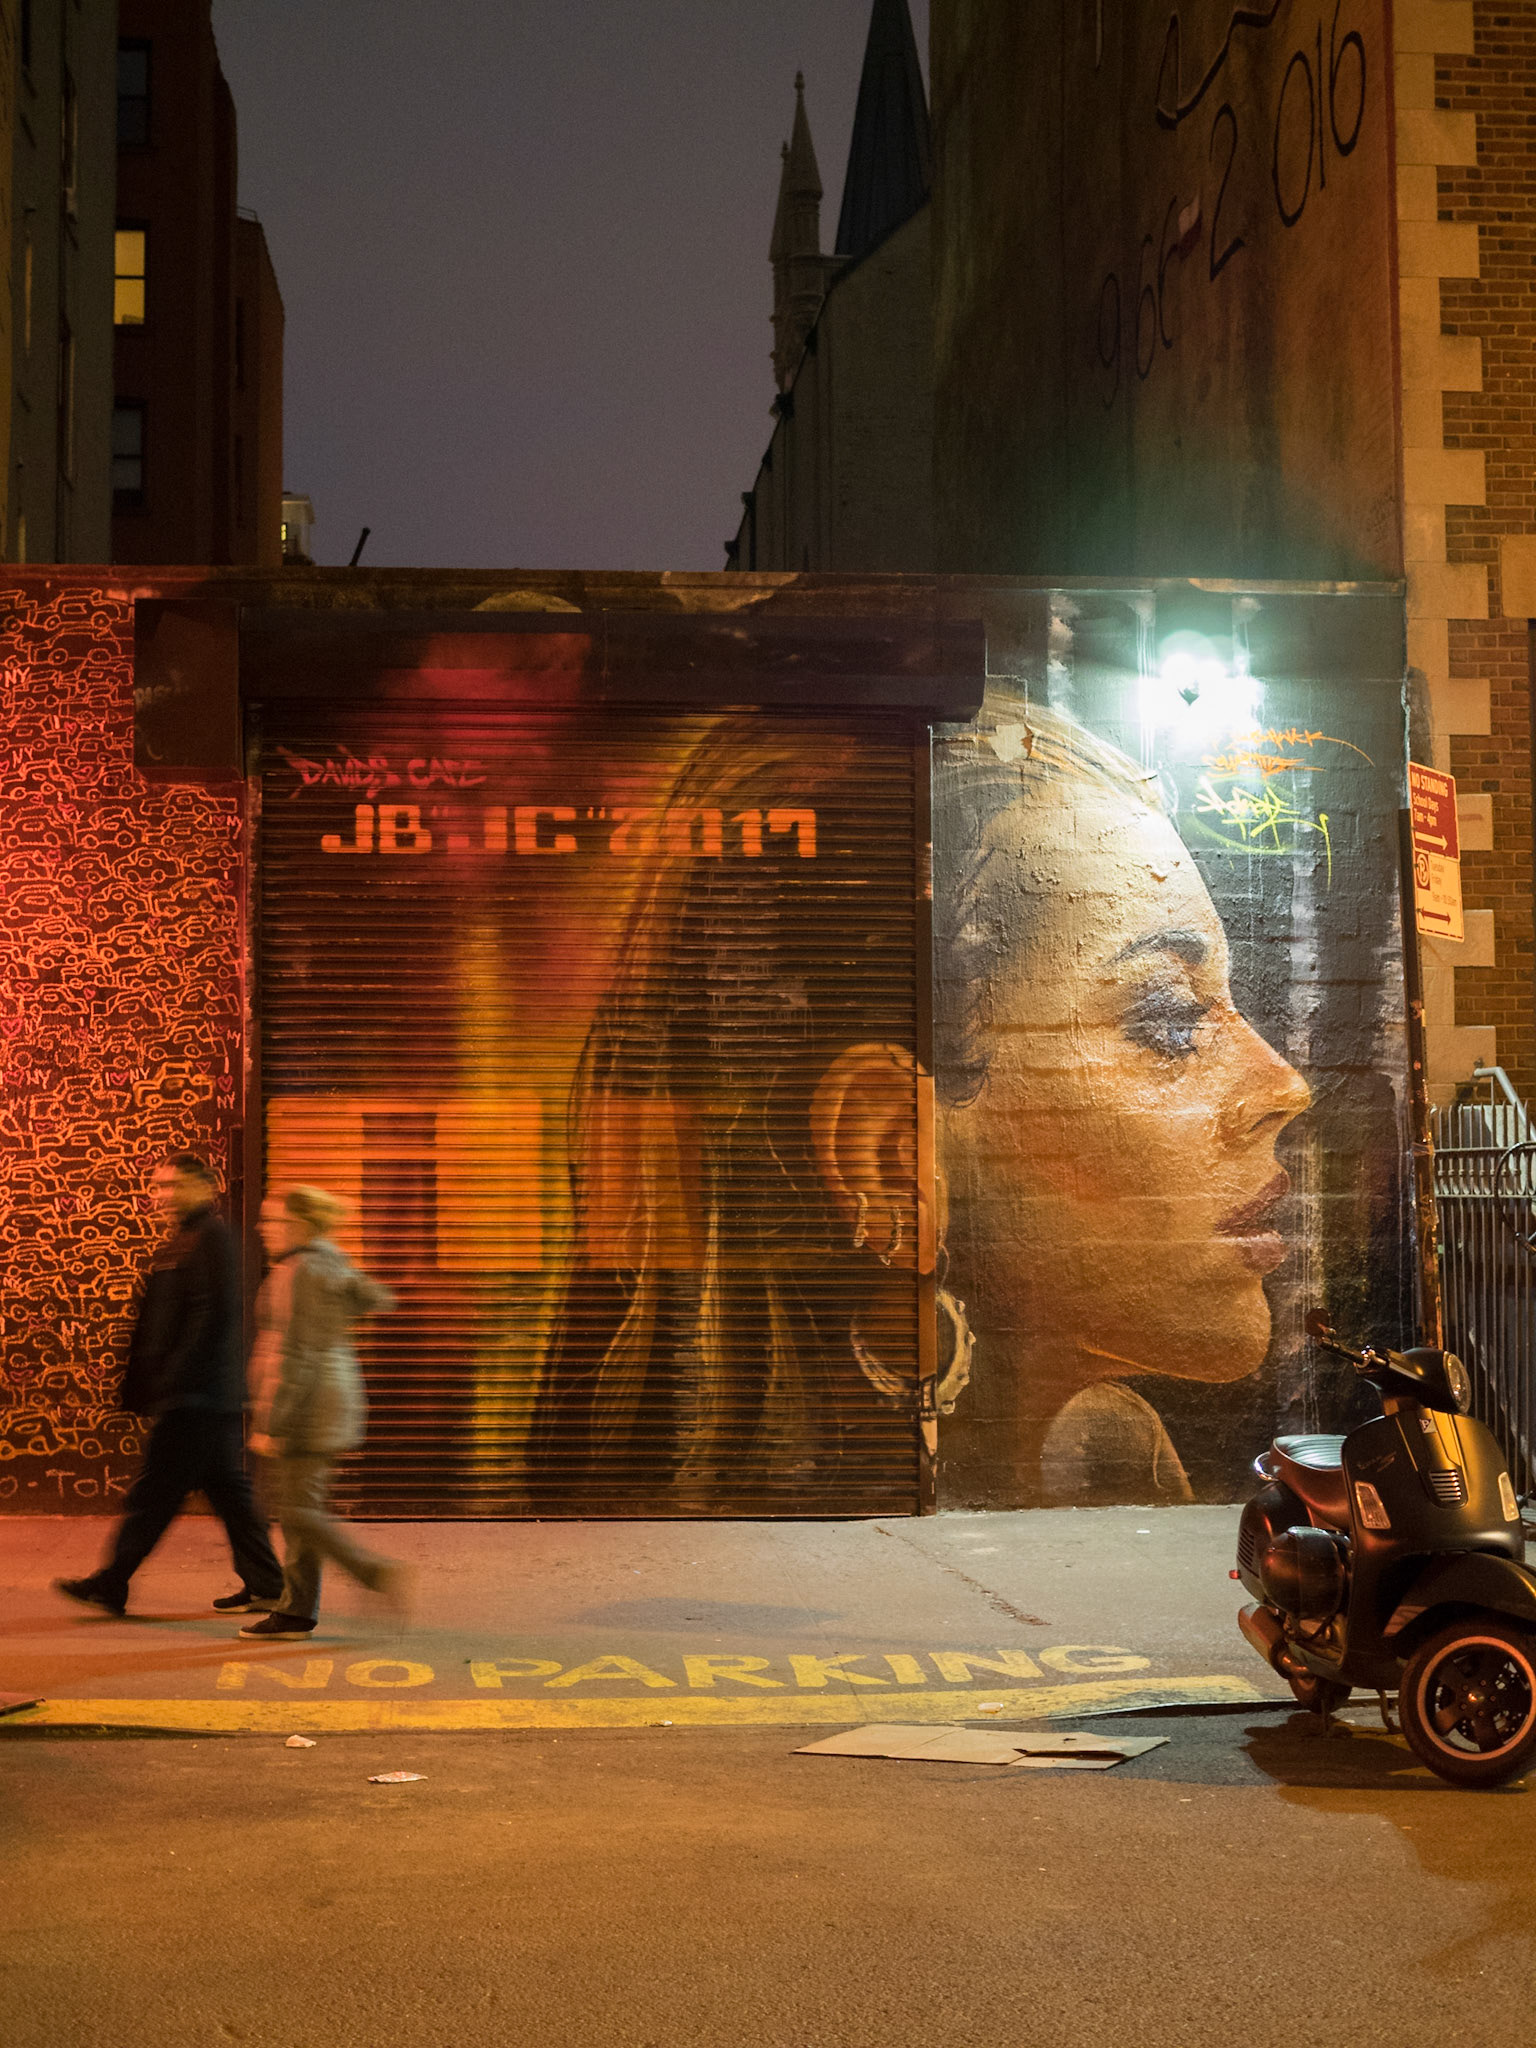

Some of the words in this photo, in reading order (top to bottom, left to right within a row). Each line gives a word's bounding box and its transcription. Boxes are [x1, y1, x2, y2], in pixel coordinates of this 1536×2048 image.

[1411, 772, 1420, 788] NO
[1421, 776, 1448, 797] STANDING
[320, 804, 432, 855] JB
[608, 806, 817, 858] 2017
[215, 1659, 435, 1690] NO
[470, 1645, 1151, 1689] PARKING
